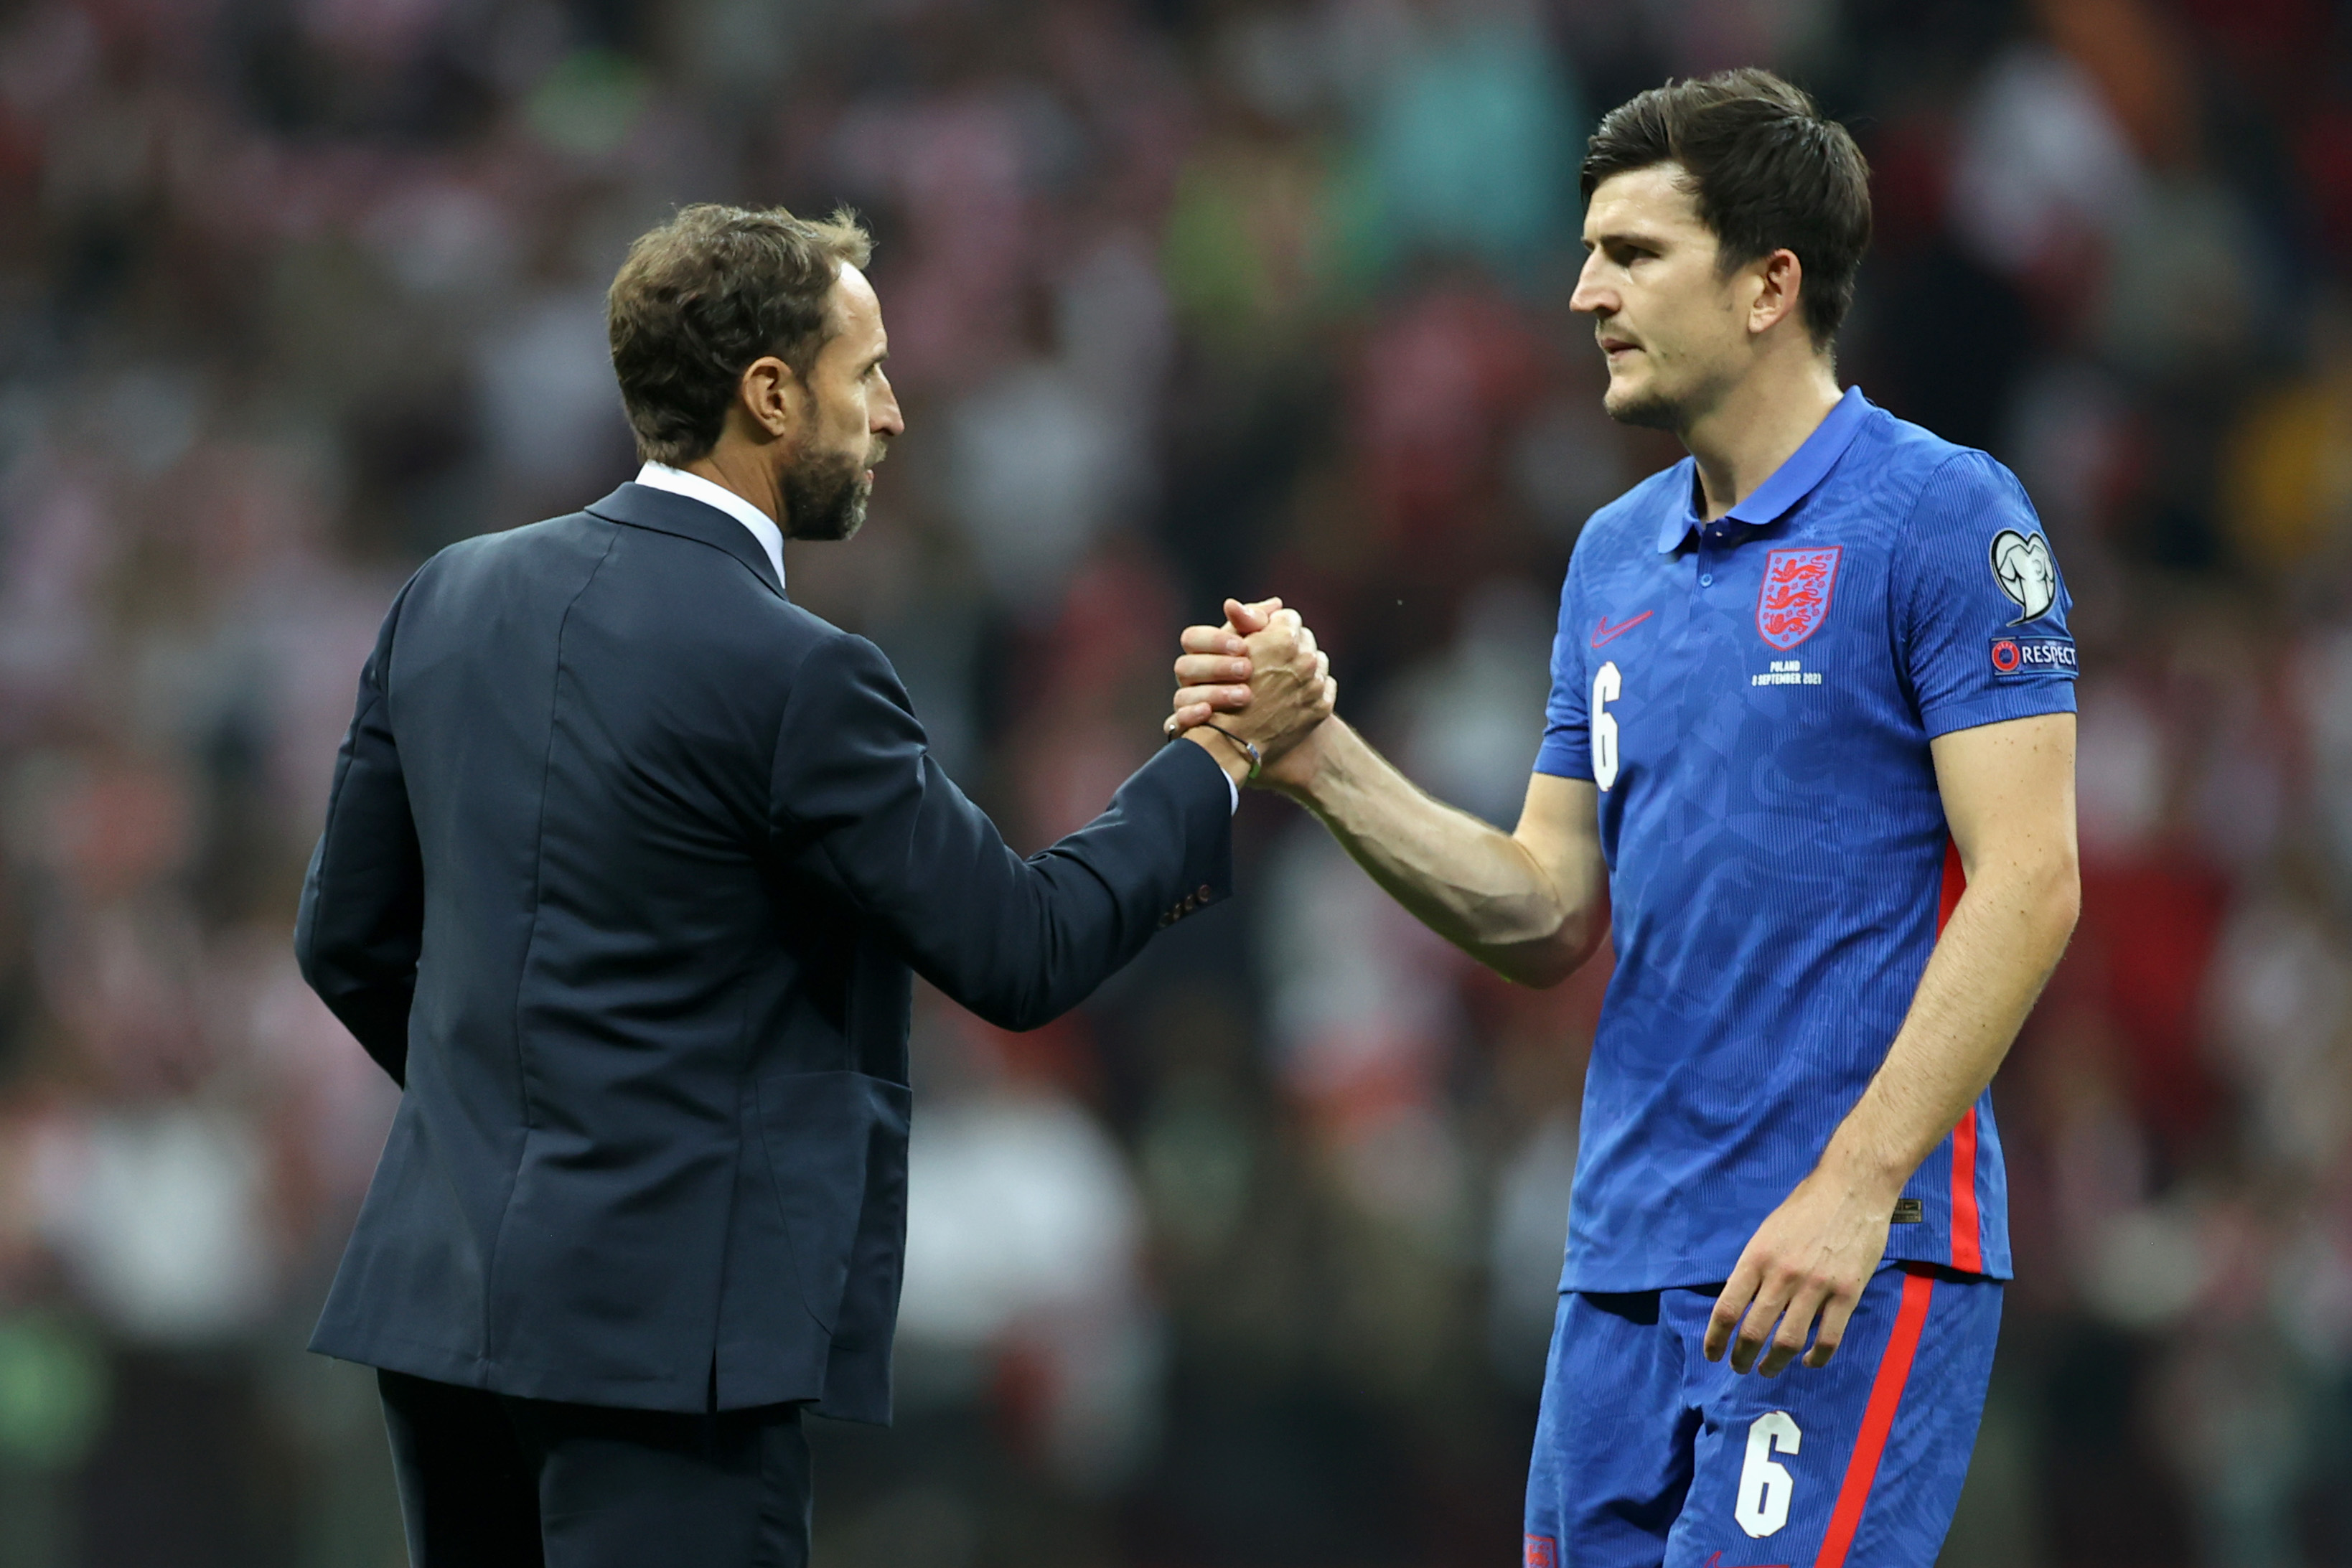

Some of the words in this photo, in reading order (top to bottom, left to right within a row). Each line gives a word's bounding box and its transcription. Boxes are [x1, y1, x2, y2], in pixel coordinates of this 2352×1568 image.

[1770, 660, 1801, 672] POLAND
[2022, 645, 2076, 666] RESPECT
[1758, 672, 1802, 685] SEPTEMBER
[1803, 672, 1822, 685] 2021
[1592, 661, 1622, 793] 6
[1734, 1410, 1802, 1539] 6
